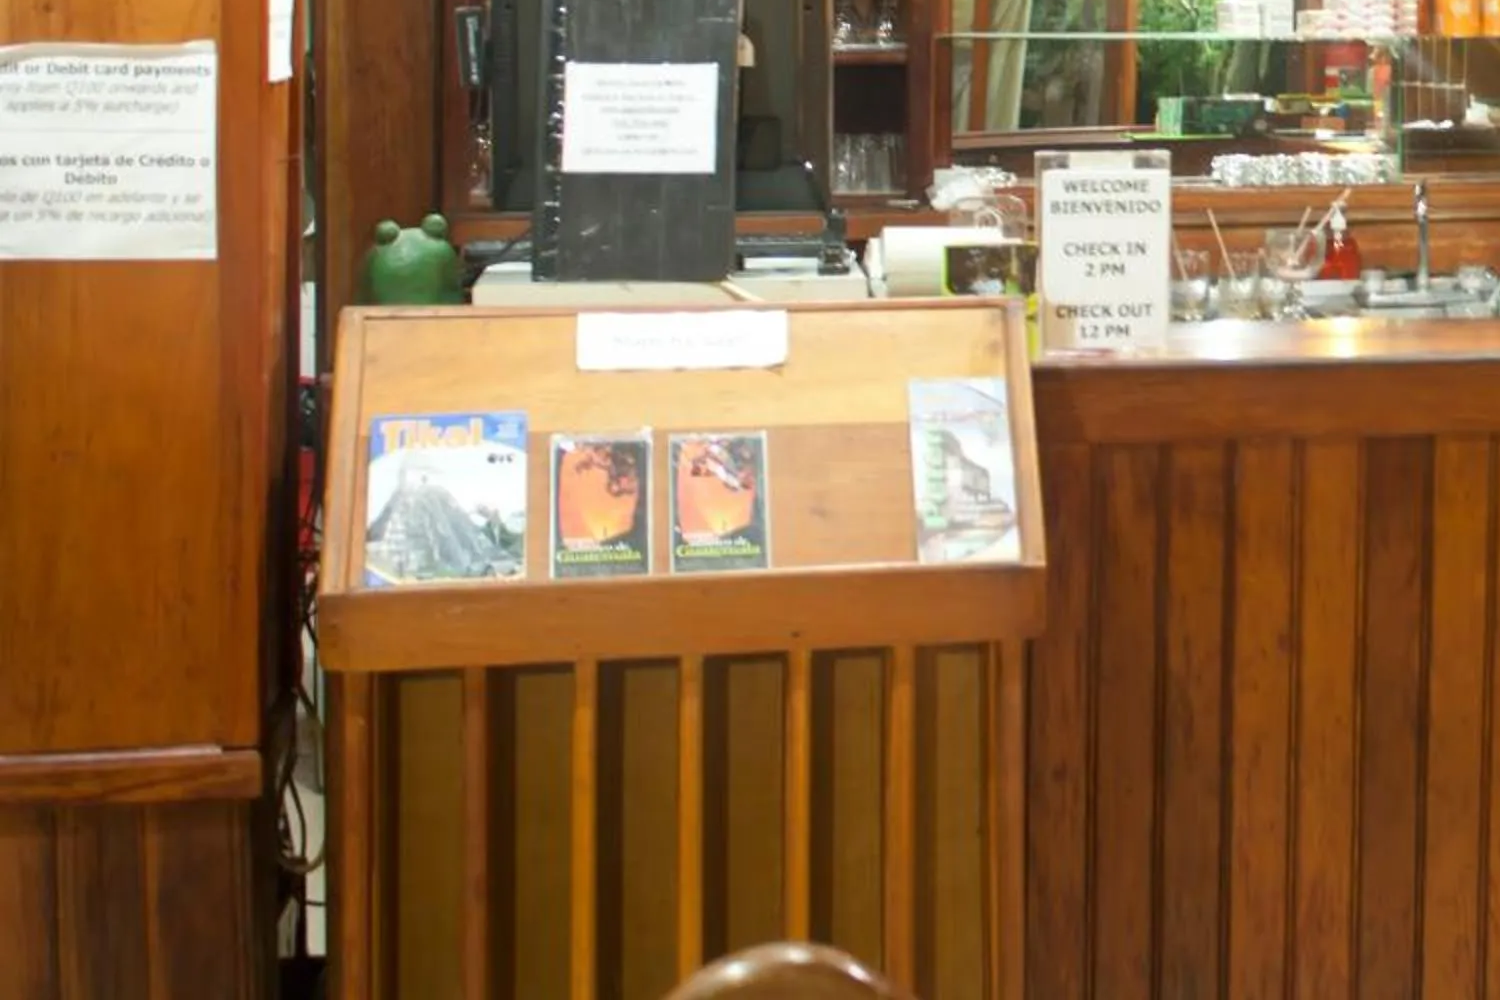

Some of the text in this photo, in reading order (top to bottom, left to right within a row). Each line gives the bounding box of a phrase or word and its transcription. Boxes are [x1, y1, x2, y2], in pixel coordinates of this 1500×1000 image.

[47, 62, 89, 75] Debit
[133, 64, 211, 78] payments
[56, 154, 110, 169] tarjeta
[115, 155, 134, 167] de
[1063, 179, 1150, 194] WELCOME
[1050, 199, 1162, 214] BIENVENIDO
[1063, 241, 1147, 256] CHECK IN
[1084, 262, 1126, 277] 2 PM
[1055, 303, 1153, 319] CHECK OUT
[1080, 323, 1131, 339] 12 PM
[380, 416, 484, 452] Tikal
